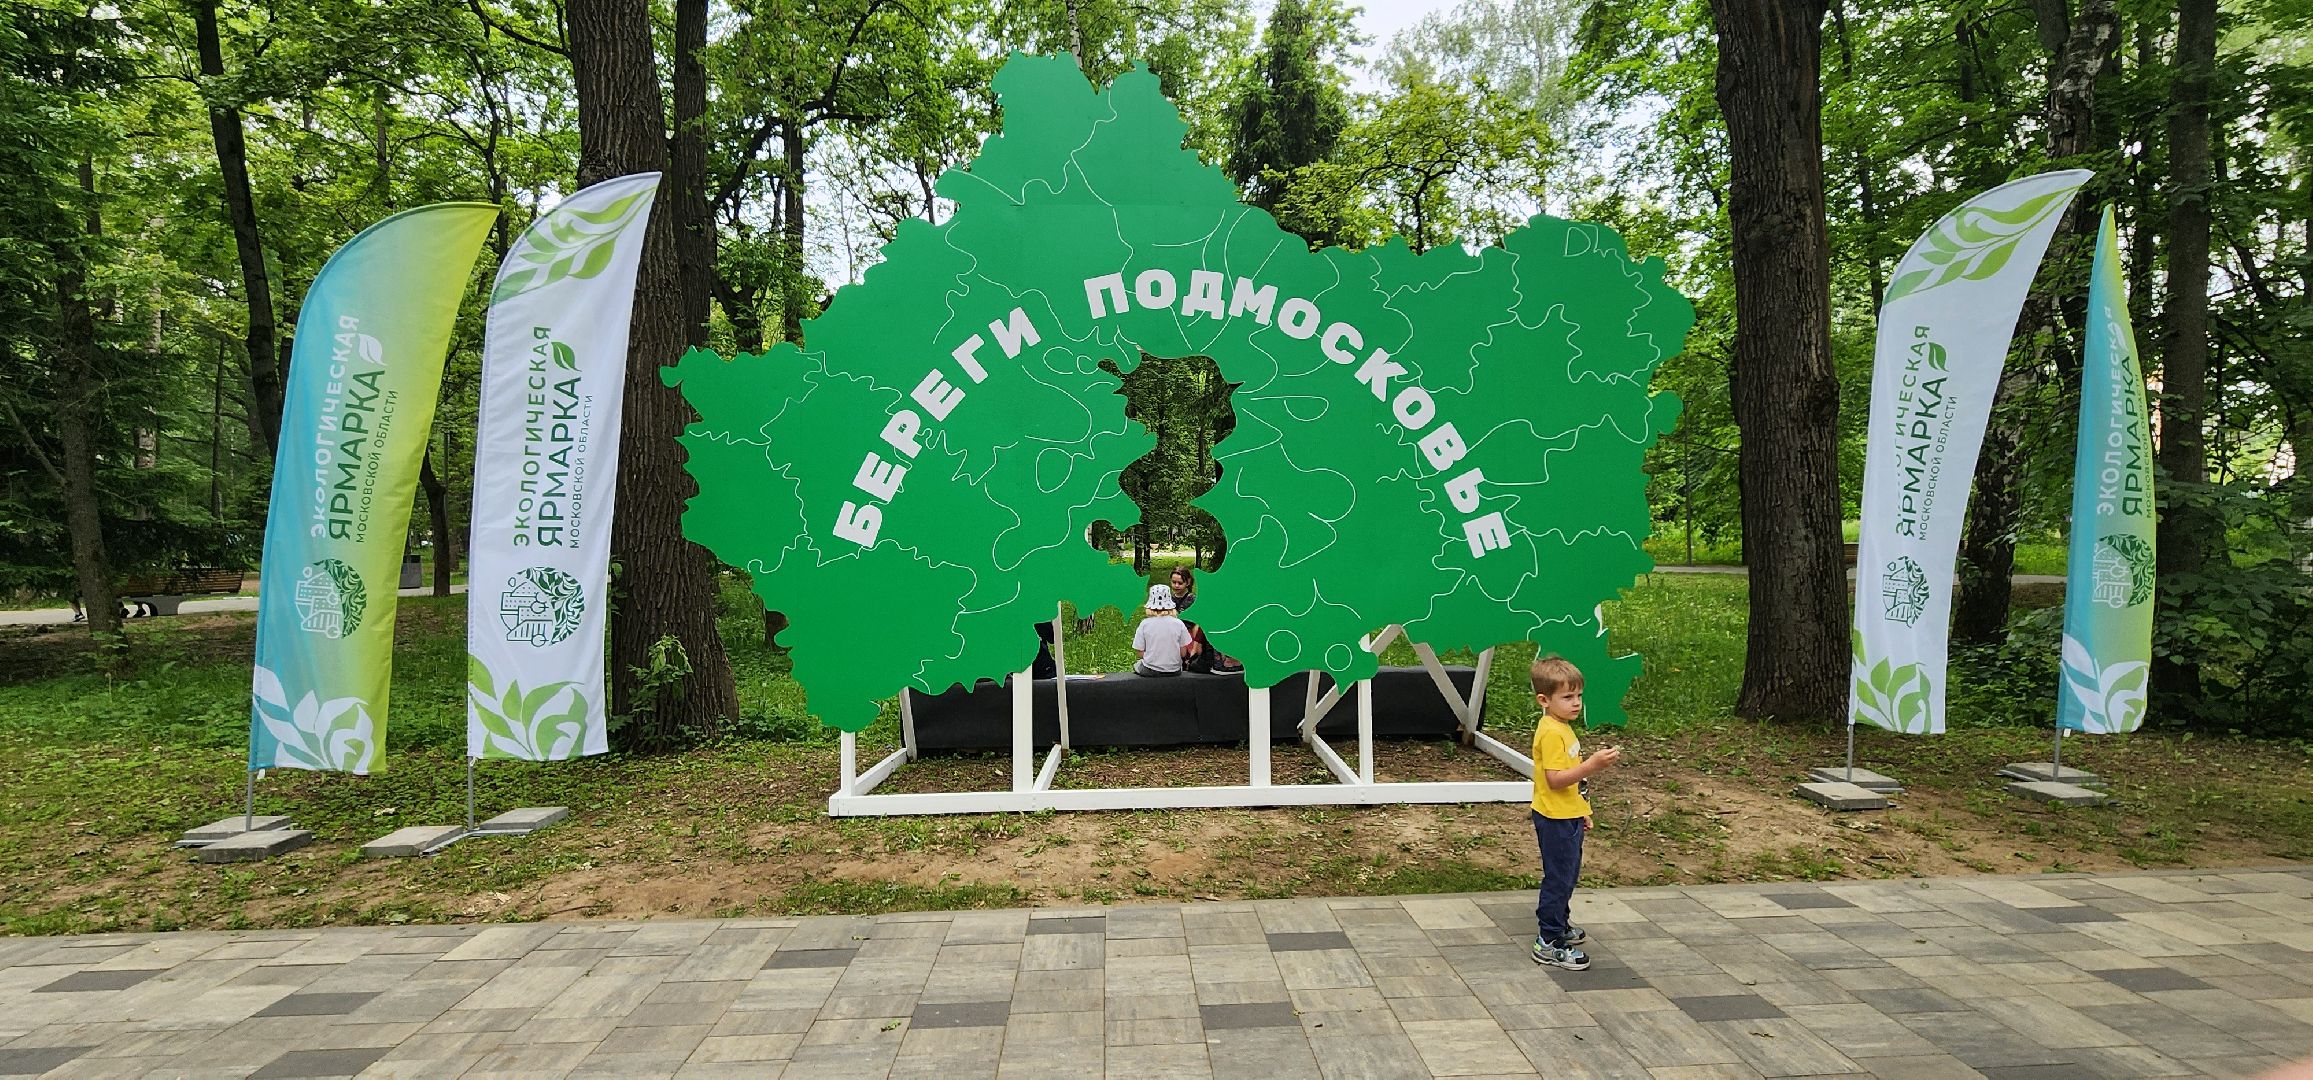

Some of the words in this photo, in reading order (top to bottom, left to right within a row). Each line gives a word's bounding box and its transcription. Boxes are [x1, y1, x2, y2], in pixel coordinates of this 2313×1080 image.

[311, 315, 360, 539] ЭКОЛОГИЧЕСКАЯ
[328, 370, 385, 541] ЯРМАРКА
[355, 452, 382, 544] МОСКОВСКОЙ
[373, 390, 399, 449] ОБЛАСТИ
[513, 326, 552, 547] ЭКОЛОГИЧЕСКАЯ
[537, 376, 582, 547] ЯРМАРКА
[577, 394, 593, 453] ОБЛАСТИ
[832, 306, 1041, 549] БЕРЕГИ
[1083, 268, 1511, 560] ПОДМОСКОВЬЕ
[1902, 376, 1948, 538] ЯРМАРКА
[1918, 457, 1942, 542] МОСКОВСКОЙ
[1935, 396, 1958, 453] ОБЛАСТИ
[2096, 306, 2123, 517] ЭКОЛОГИЧЕСКАЯ
[2121, 355, 2143, 517] ЯРМАРКА
[2141, 432, 2152, 519] МОСКОВСКОЙ
[569, 457, 586, 549] МОСКОВСКОЙ
